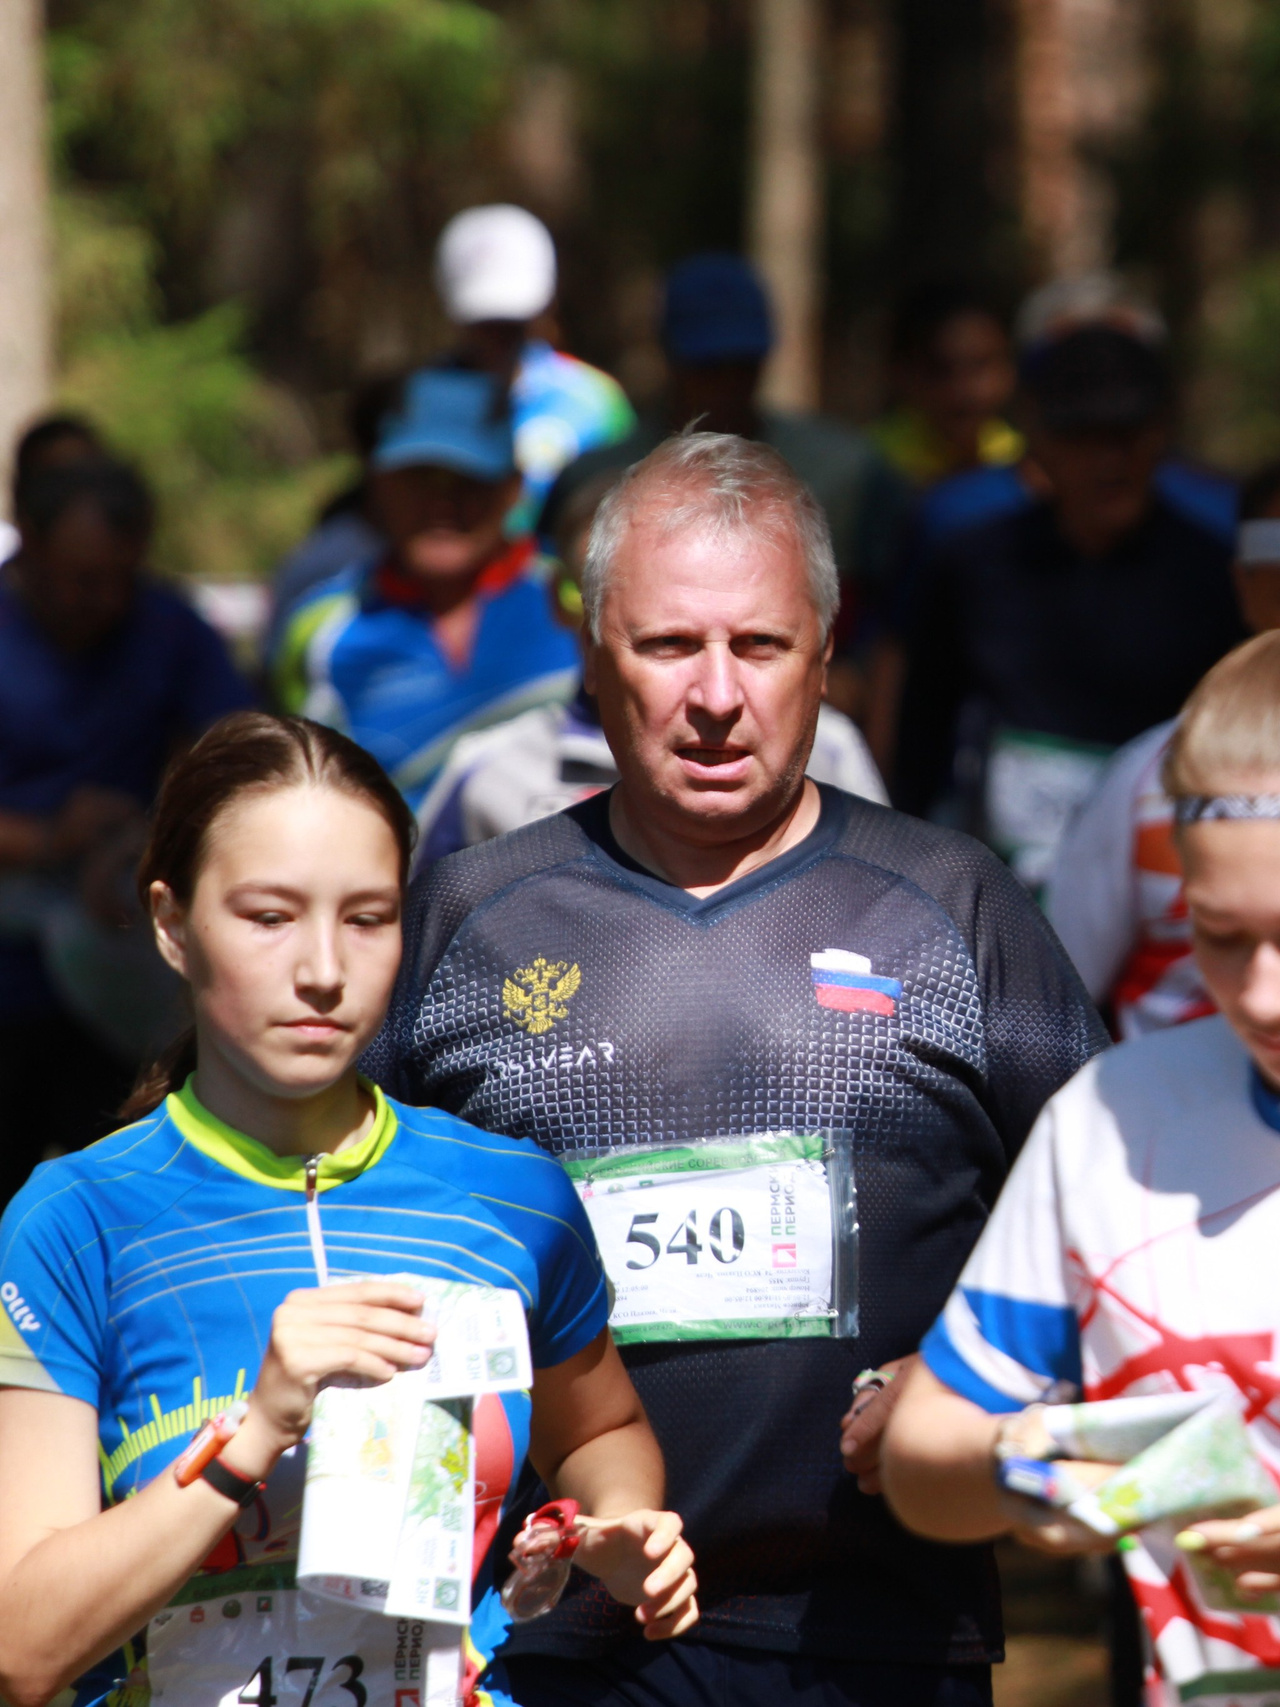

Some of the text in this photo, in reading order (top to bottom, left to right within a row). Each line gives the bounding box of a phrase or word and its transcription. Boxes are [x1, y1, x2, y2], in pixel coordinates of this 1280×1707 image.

[625, 1206, 746, 1271] 540
[1, 1281, 41, 1330] OLLY
[238, 1655, 367, 1707] 473
